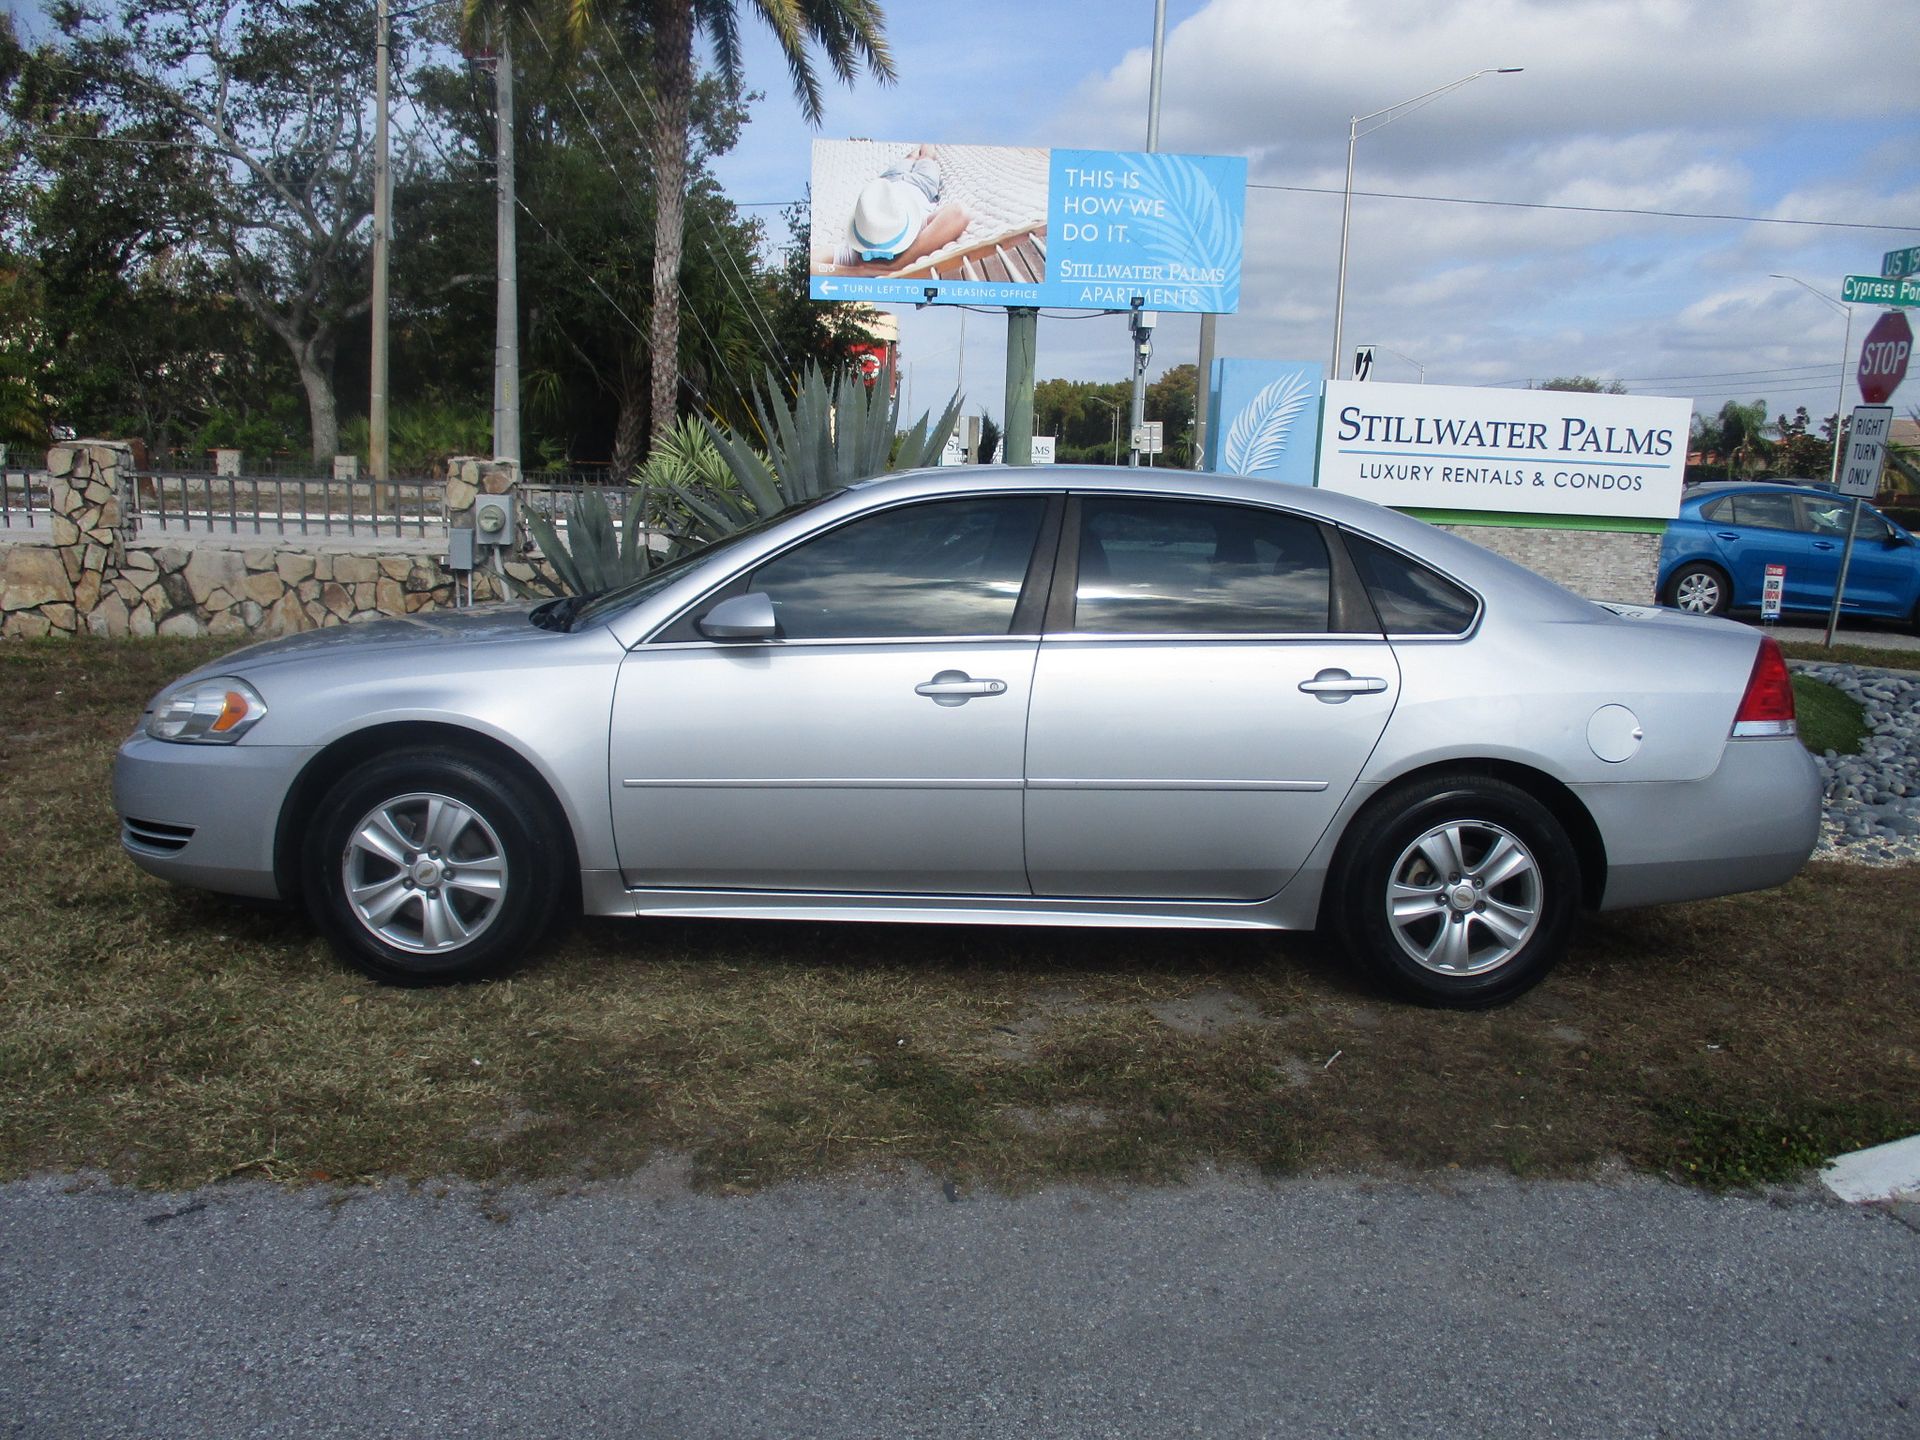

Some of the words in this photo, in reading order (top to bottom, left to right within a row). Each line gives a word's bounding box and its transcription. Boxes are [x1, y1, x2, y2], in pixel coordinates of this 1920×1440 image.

[1064, 168, 1114, 189] THIS
[1123, 171, 1141, 189] IS
[1064, 196, 1124, 215] HOW
[1129, 199, 1166, 217] WE
[1063, 223, 1099, 242] DO
[1107, 224, 1131, 243] IT.
[1060, 259, 1163, 281] STILLWATER
[1168, 263, 1225, 282] PALMS
[1885, 252, 1904, 276] US
[843, 284, 873, 293] TURN
[877, 285, 902, 294] LEFT
[904, 286, 919, 295] TO
[951, 288, 996, 298] LEASING
[1000, 289, 1038, 299] OFFICE
[1080, 287, 1199, 305] APARTMENTS
[1844, 277, 1896, 301] Cypress
[1861, 341, 1910, 375] STOP
[1337, 406, 1548, 450] STILLWATER
[1558, 417, 1673, 456] PALMS
[1855, 418, 1884, 436] RIGHT
[1853, 443, 1878, 461] TURN
[1360, 463, 1434, 481] LUXURY
[1442, 467, 1523, 486] RENTALS
[1532, 472, 1545, 487] &
[1554, 472, 1642, 491] CONDOS
[1848, 467, 1873, 486] ONLY
